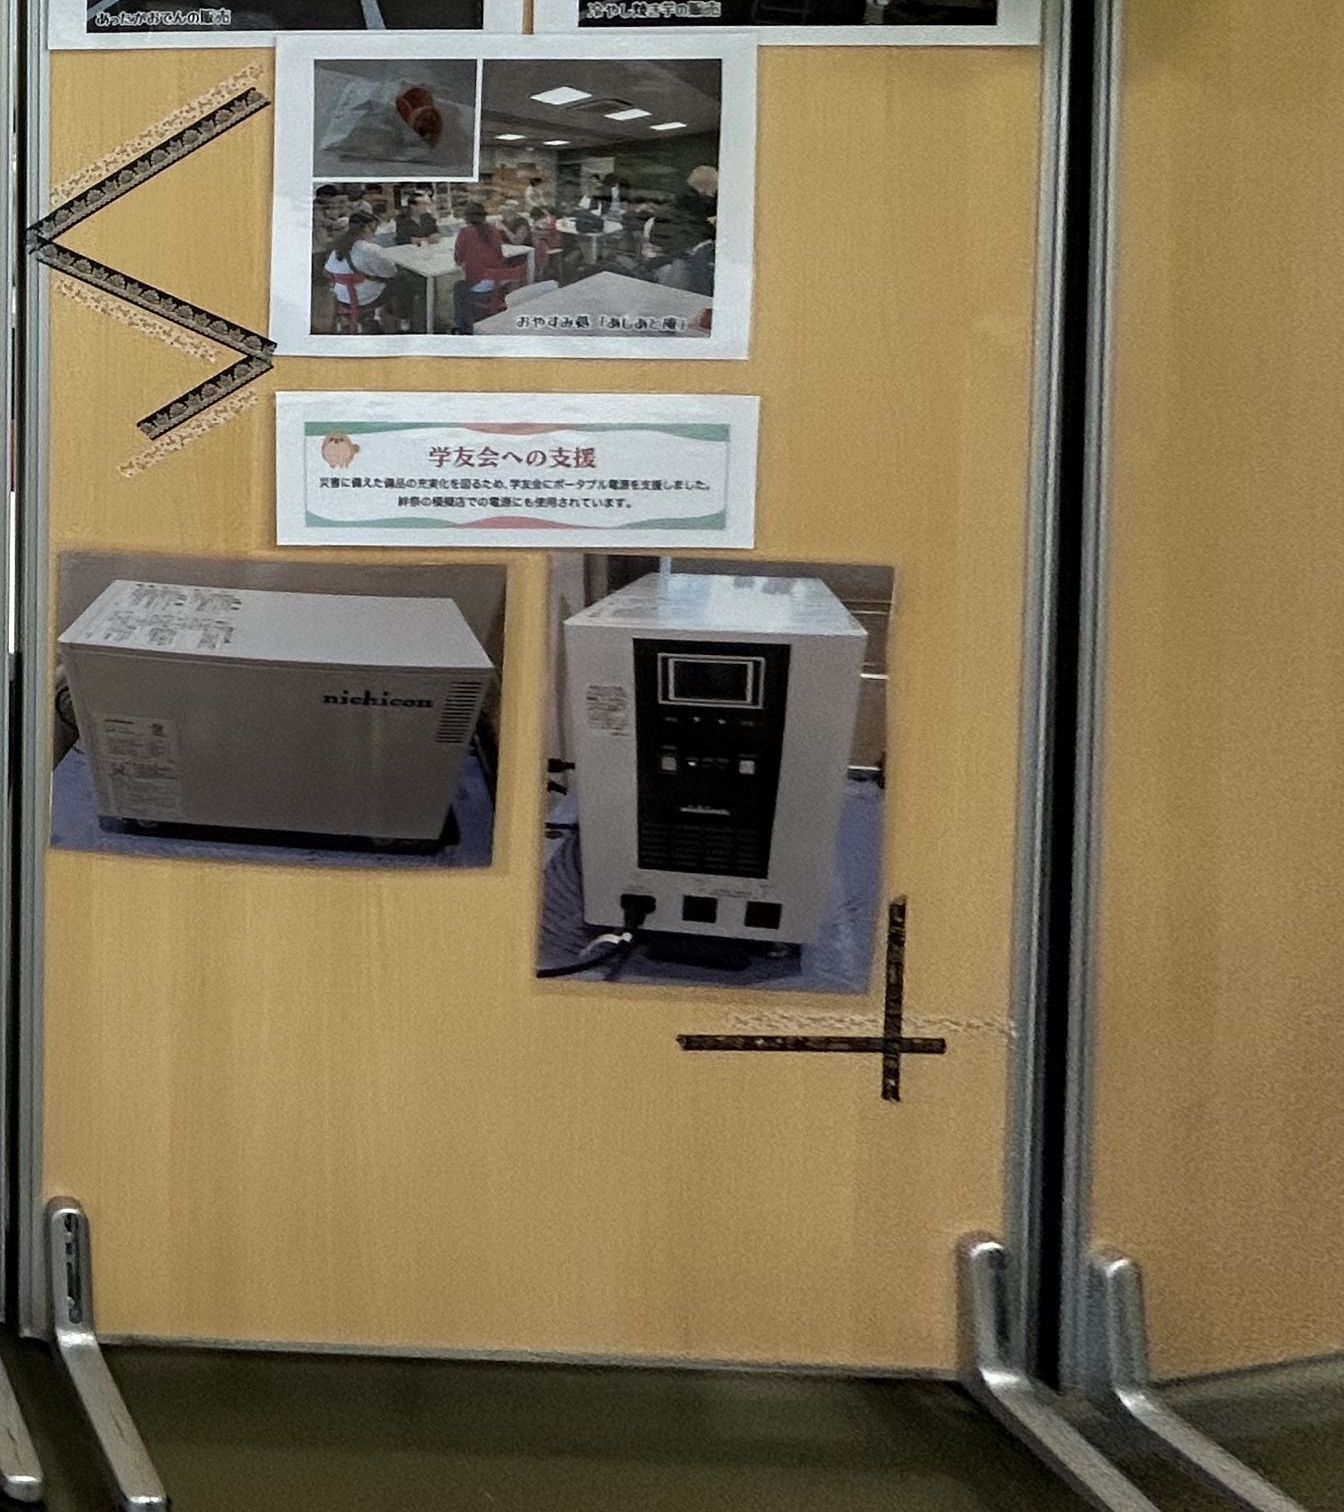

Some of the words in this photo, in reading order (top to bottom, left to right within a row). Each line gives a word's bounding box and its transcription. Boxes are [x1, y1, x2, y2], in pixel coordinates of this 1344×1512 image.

[428, 446, 597, 468] 学友会への支援
[322, 690, 433, 708] nichicon
